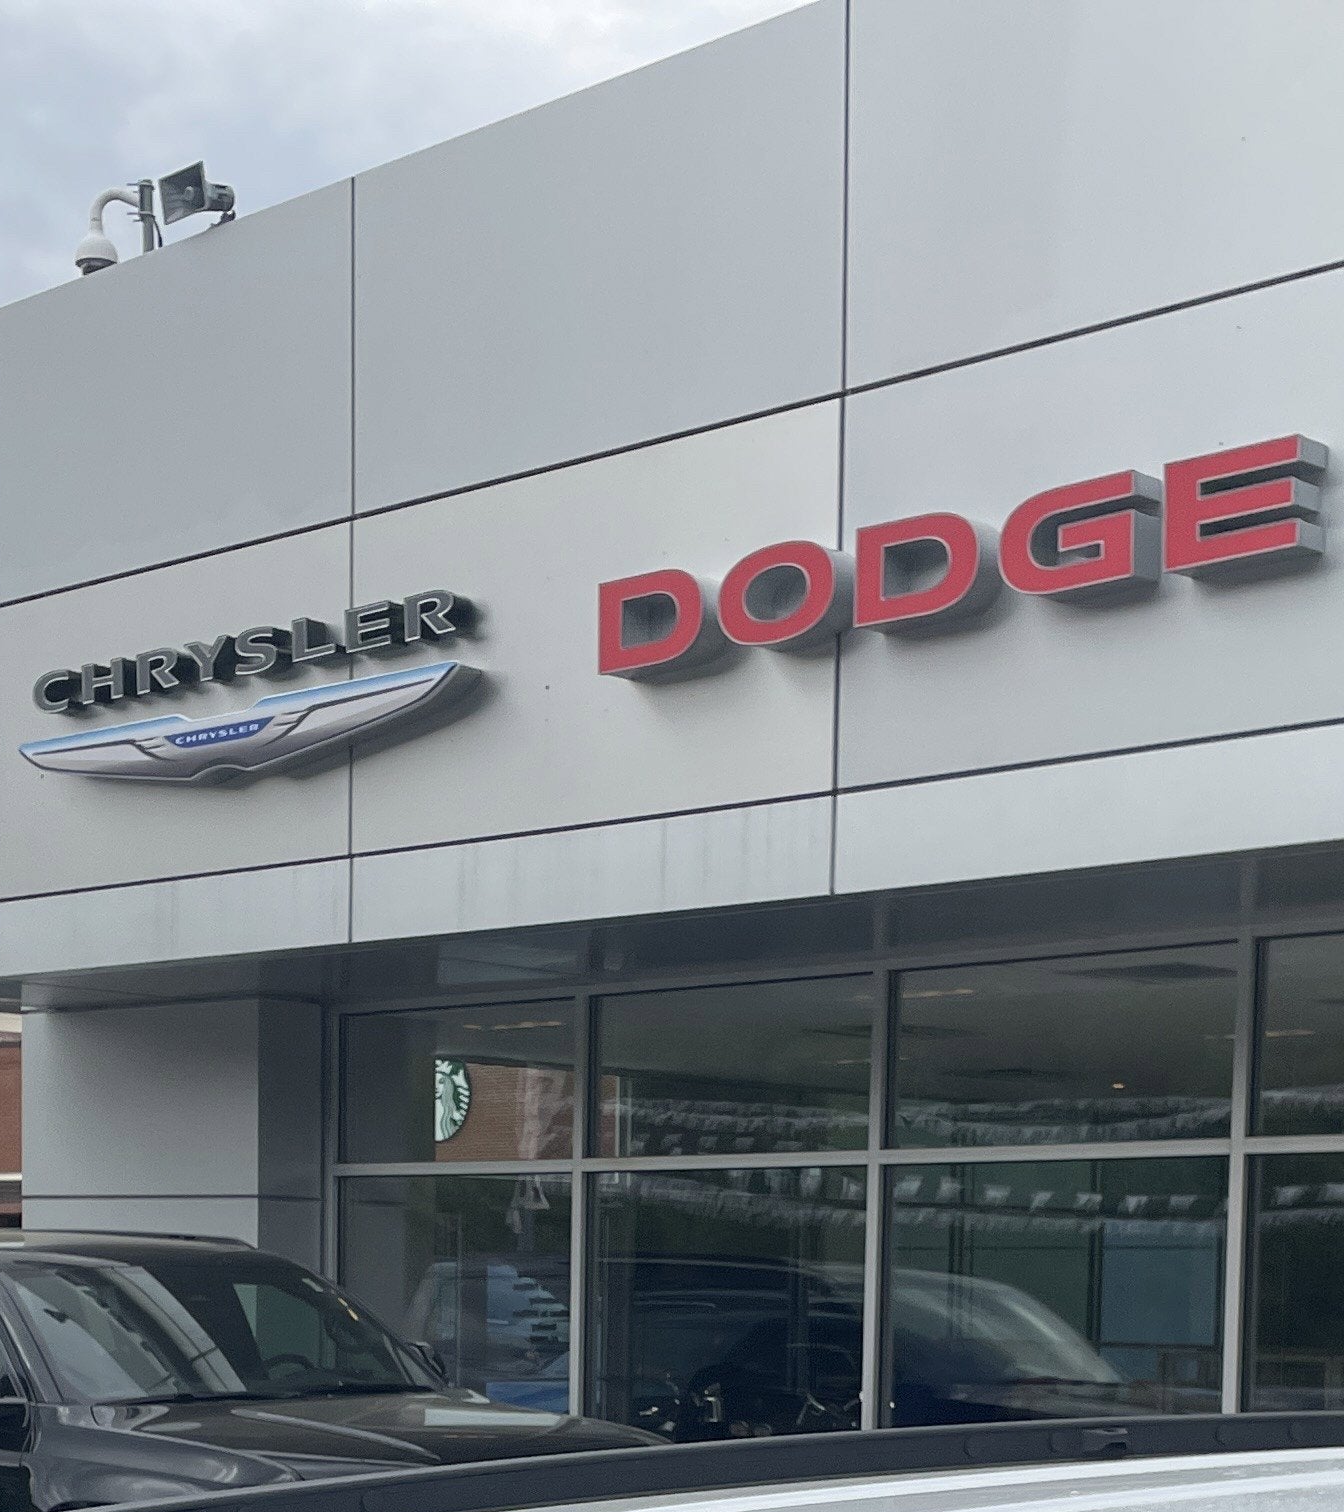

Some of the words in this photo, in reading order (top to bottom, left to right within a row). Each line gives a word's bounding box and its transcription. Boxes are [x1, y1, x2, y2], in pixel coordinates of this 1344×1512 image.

[598, 433, 1318, 677] DODGE
[31, 589, 460, 714] CHRYSLER
[175, 722, 260, 746] CHRYSLER
